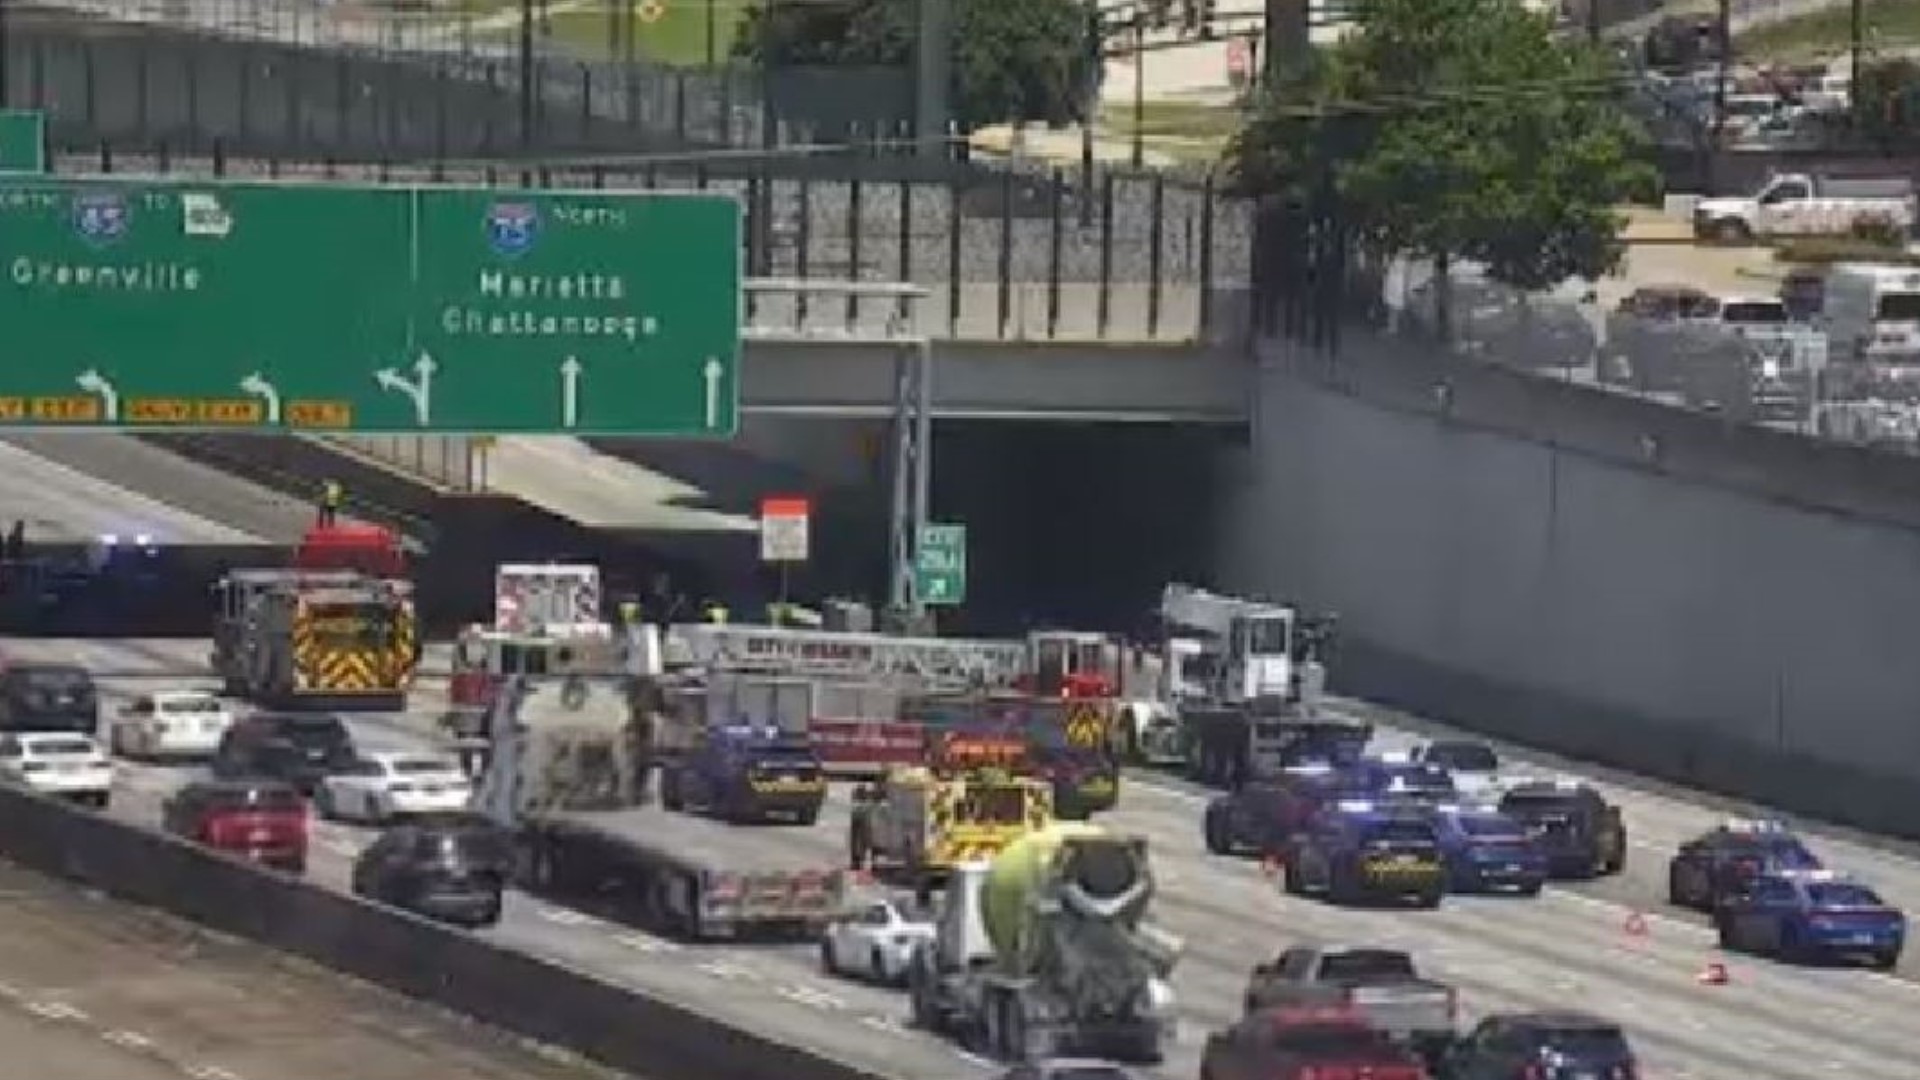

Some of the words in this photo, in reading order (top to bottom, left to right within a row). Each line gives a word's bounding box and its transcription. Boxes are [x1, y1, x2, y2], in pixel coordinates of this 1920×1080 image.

[12, 256, 201, 290] Greenville
[479, 268, 625, 299] Marietta
[442, 306, 659, 341] Chattanooga
